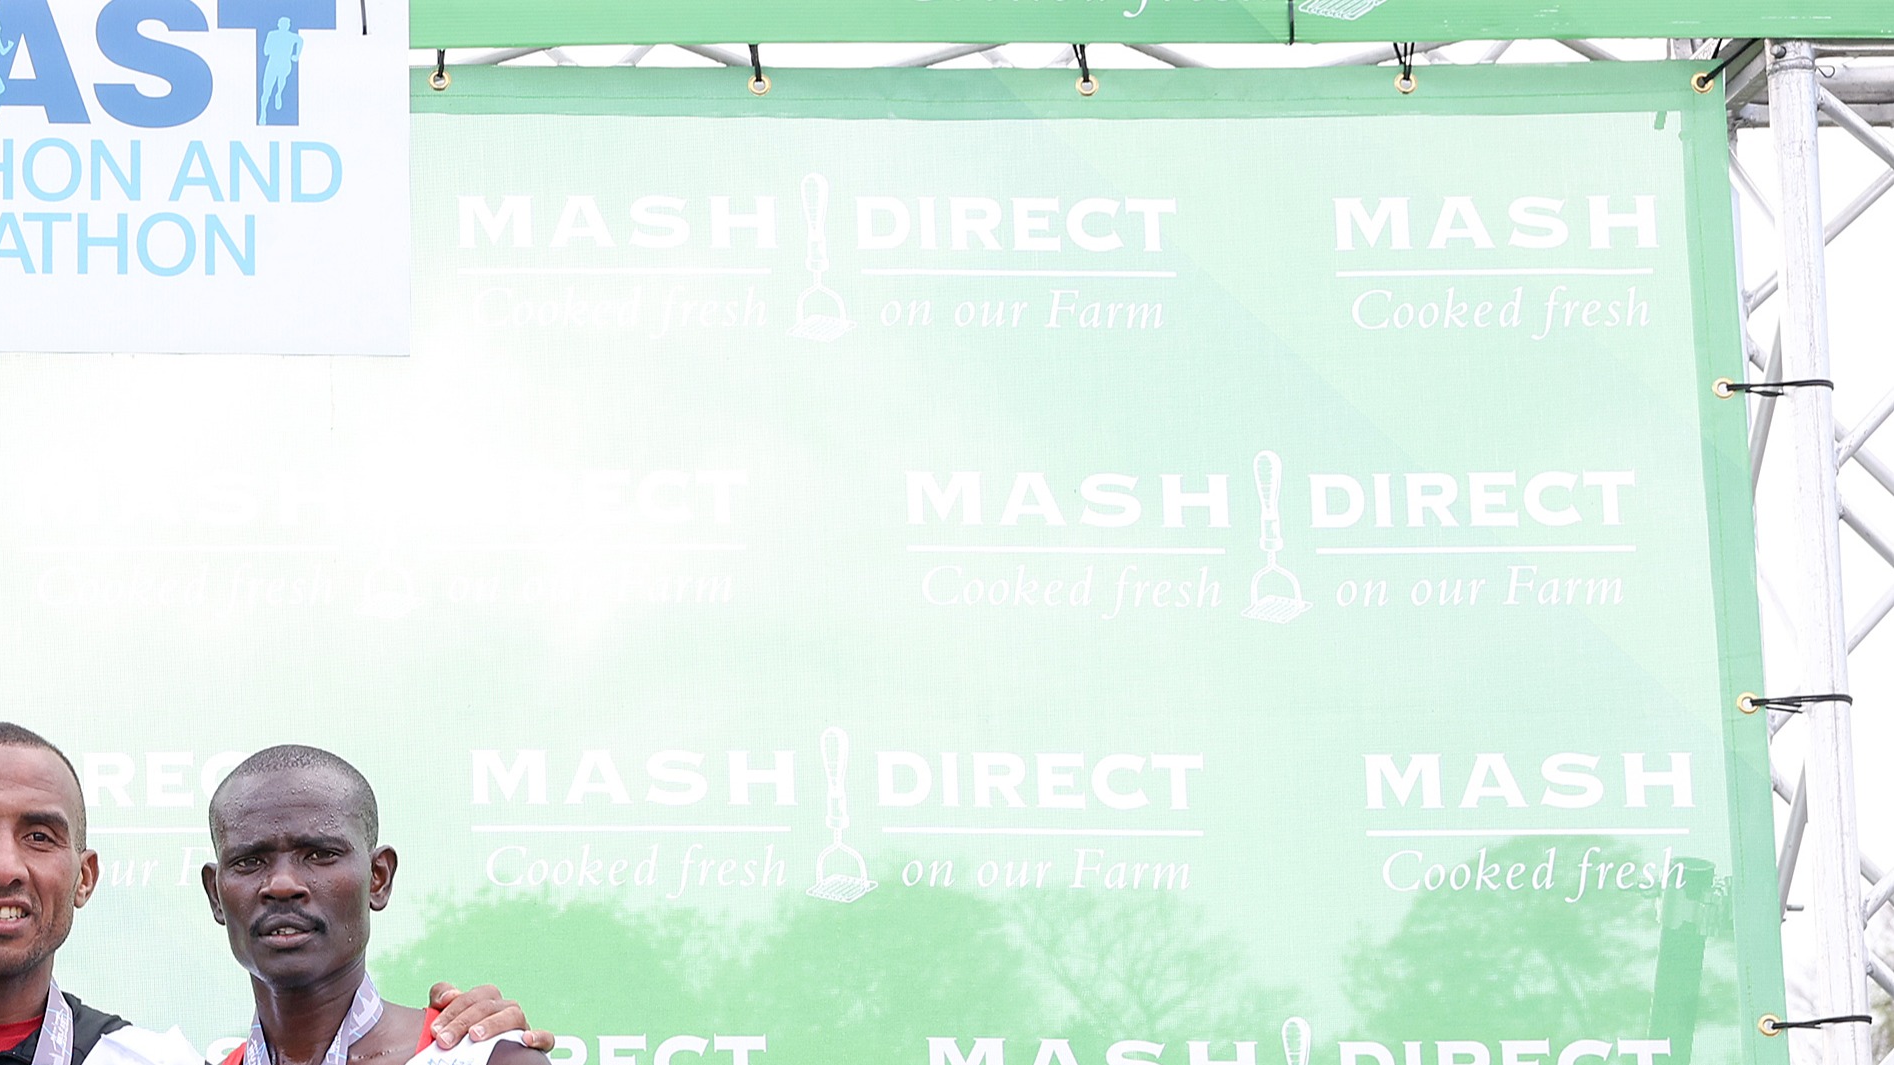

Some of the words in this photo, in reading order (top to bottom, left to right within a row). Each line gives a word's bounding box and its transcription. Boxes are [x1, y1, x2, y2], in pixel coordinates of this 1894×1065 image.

[169, 140, 343, 203] AND
[854, 198, 1176, 251] DIRECT
[1334, 194, 1657, 251] MASH
[906, 471, 1231, 526] MASH
[1310, 469, 1637, 528] DIRECT
[920, 563, 1094, 606] Cooked
[1335, 580, 1388, 608] on
[1410, 579, 1486, 606] our
[1506, 565, 1624, 605] Farm
[472, 746, 794, 805] MASH
[875, 749, 1204, 809] DIRECT
[1365, 752, 1694, 809] MASH
